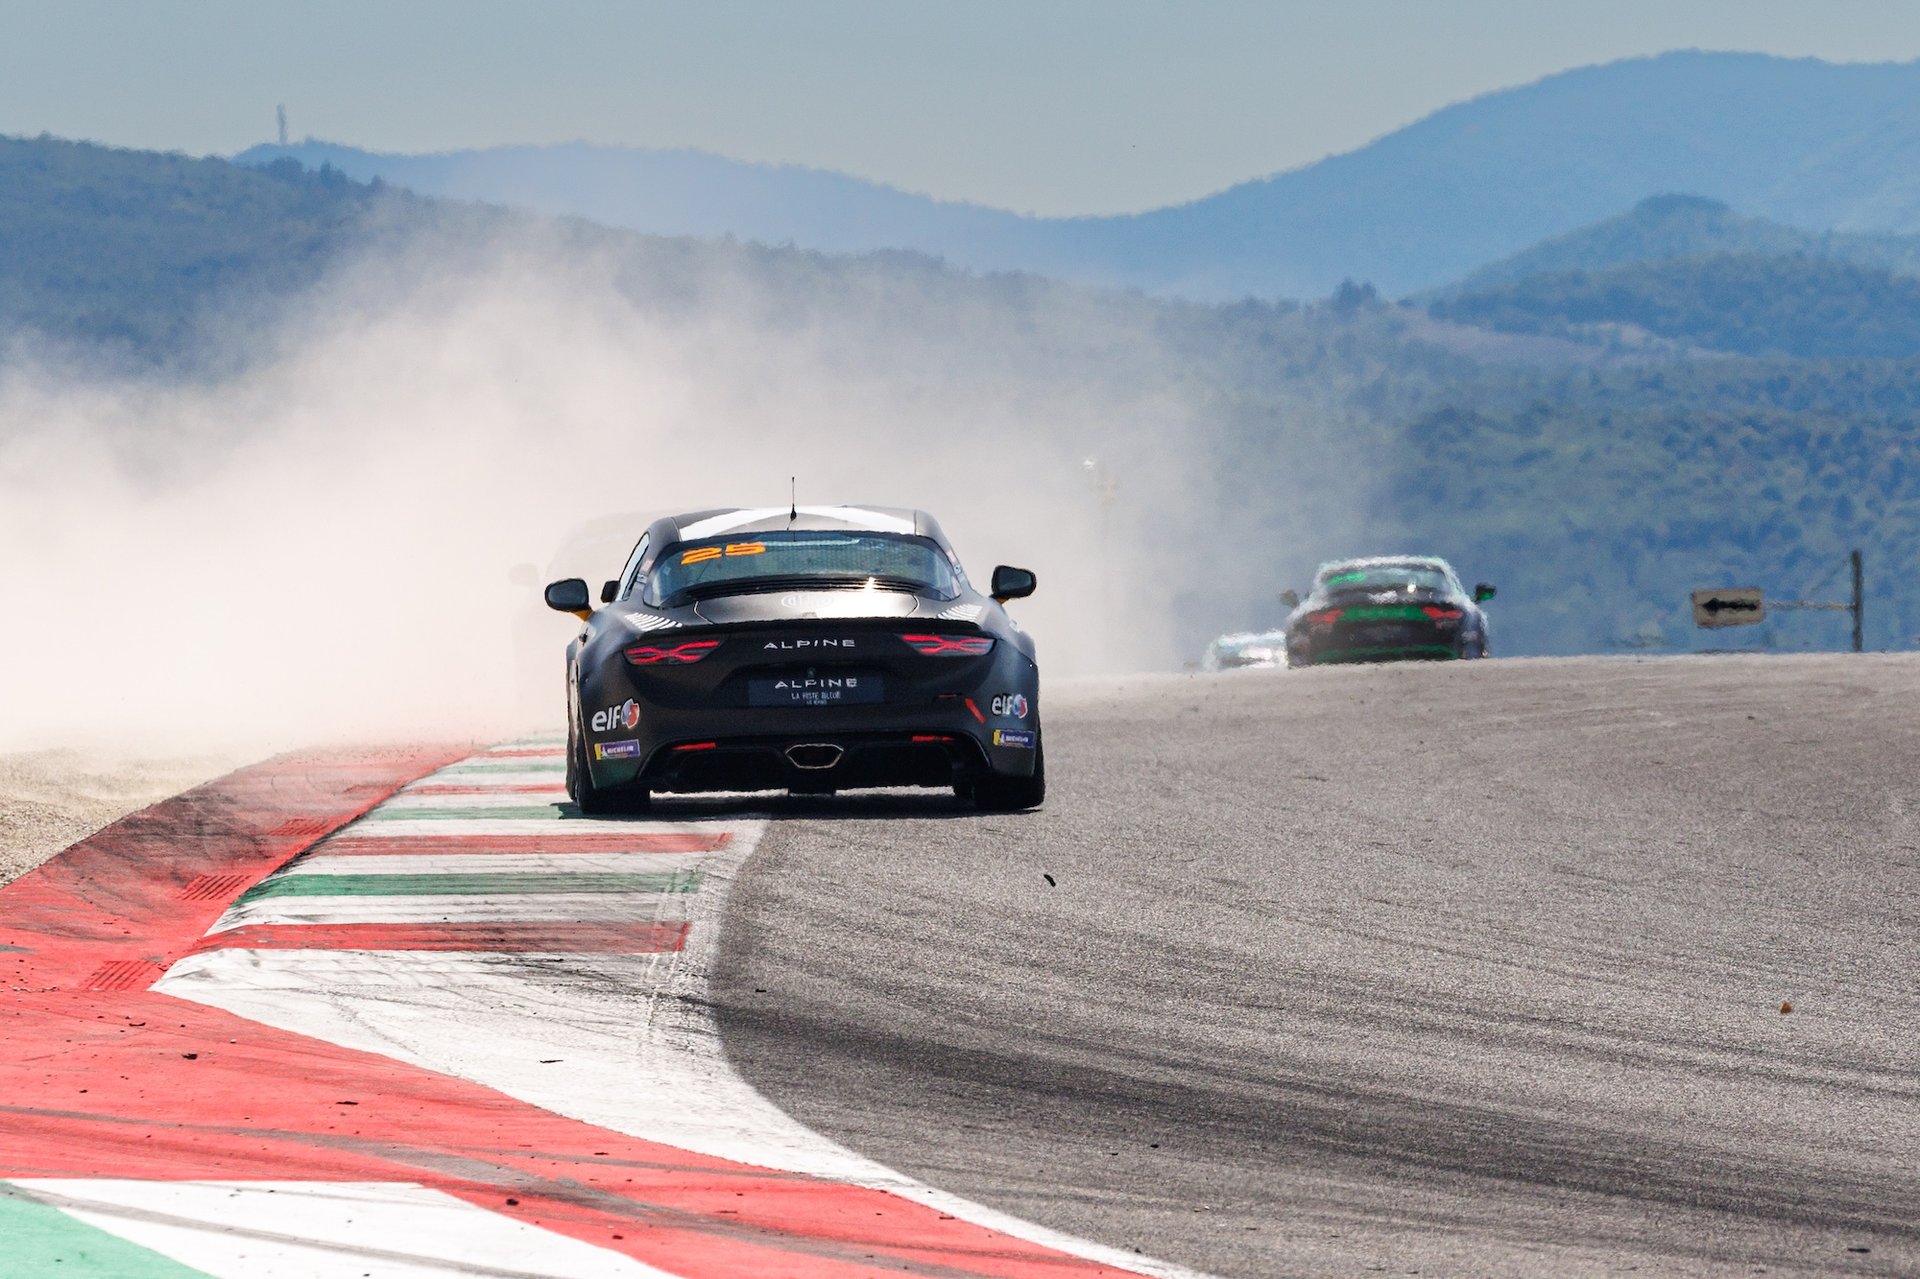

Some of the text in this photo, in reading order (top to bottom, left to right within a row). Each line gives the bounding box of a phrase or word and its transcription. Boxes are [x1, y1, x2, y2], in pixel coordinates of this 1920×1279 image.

[680, 541, 766, 565] 25
[763, 639, 855, 650] ALPINE
[774, 678, 857, 689] ALPINE
[992, 696, 1013, 715] elf
[591, 705, 621, 732] elf
